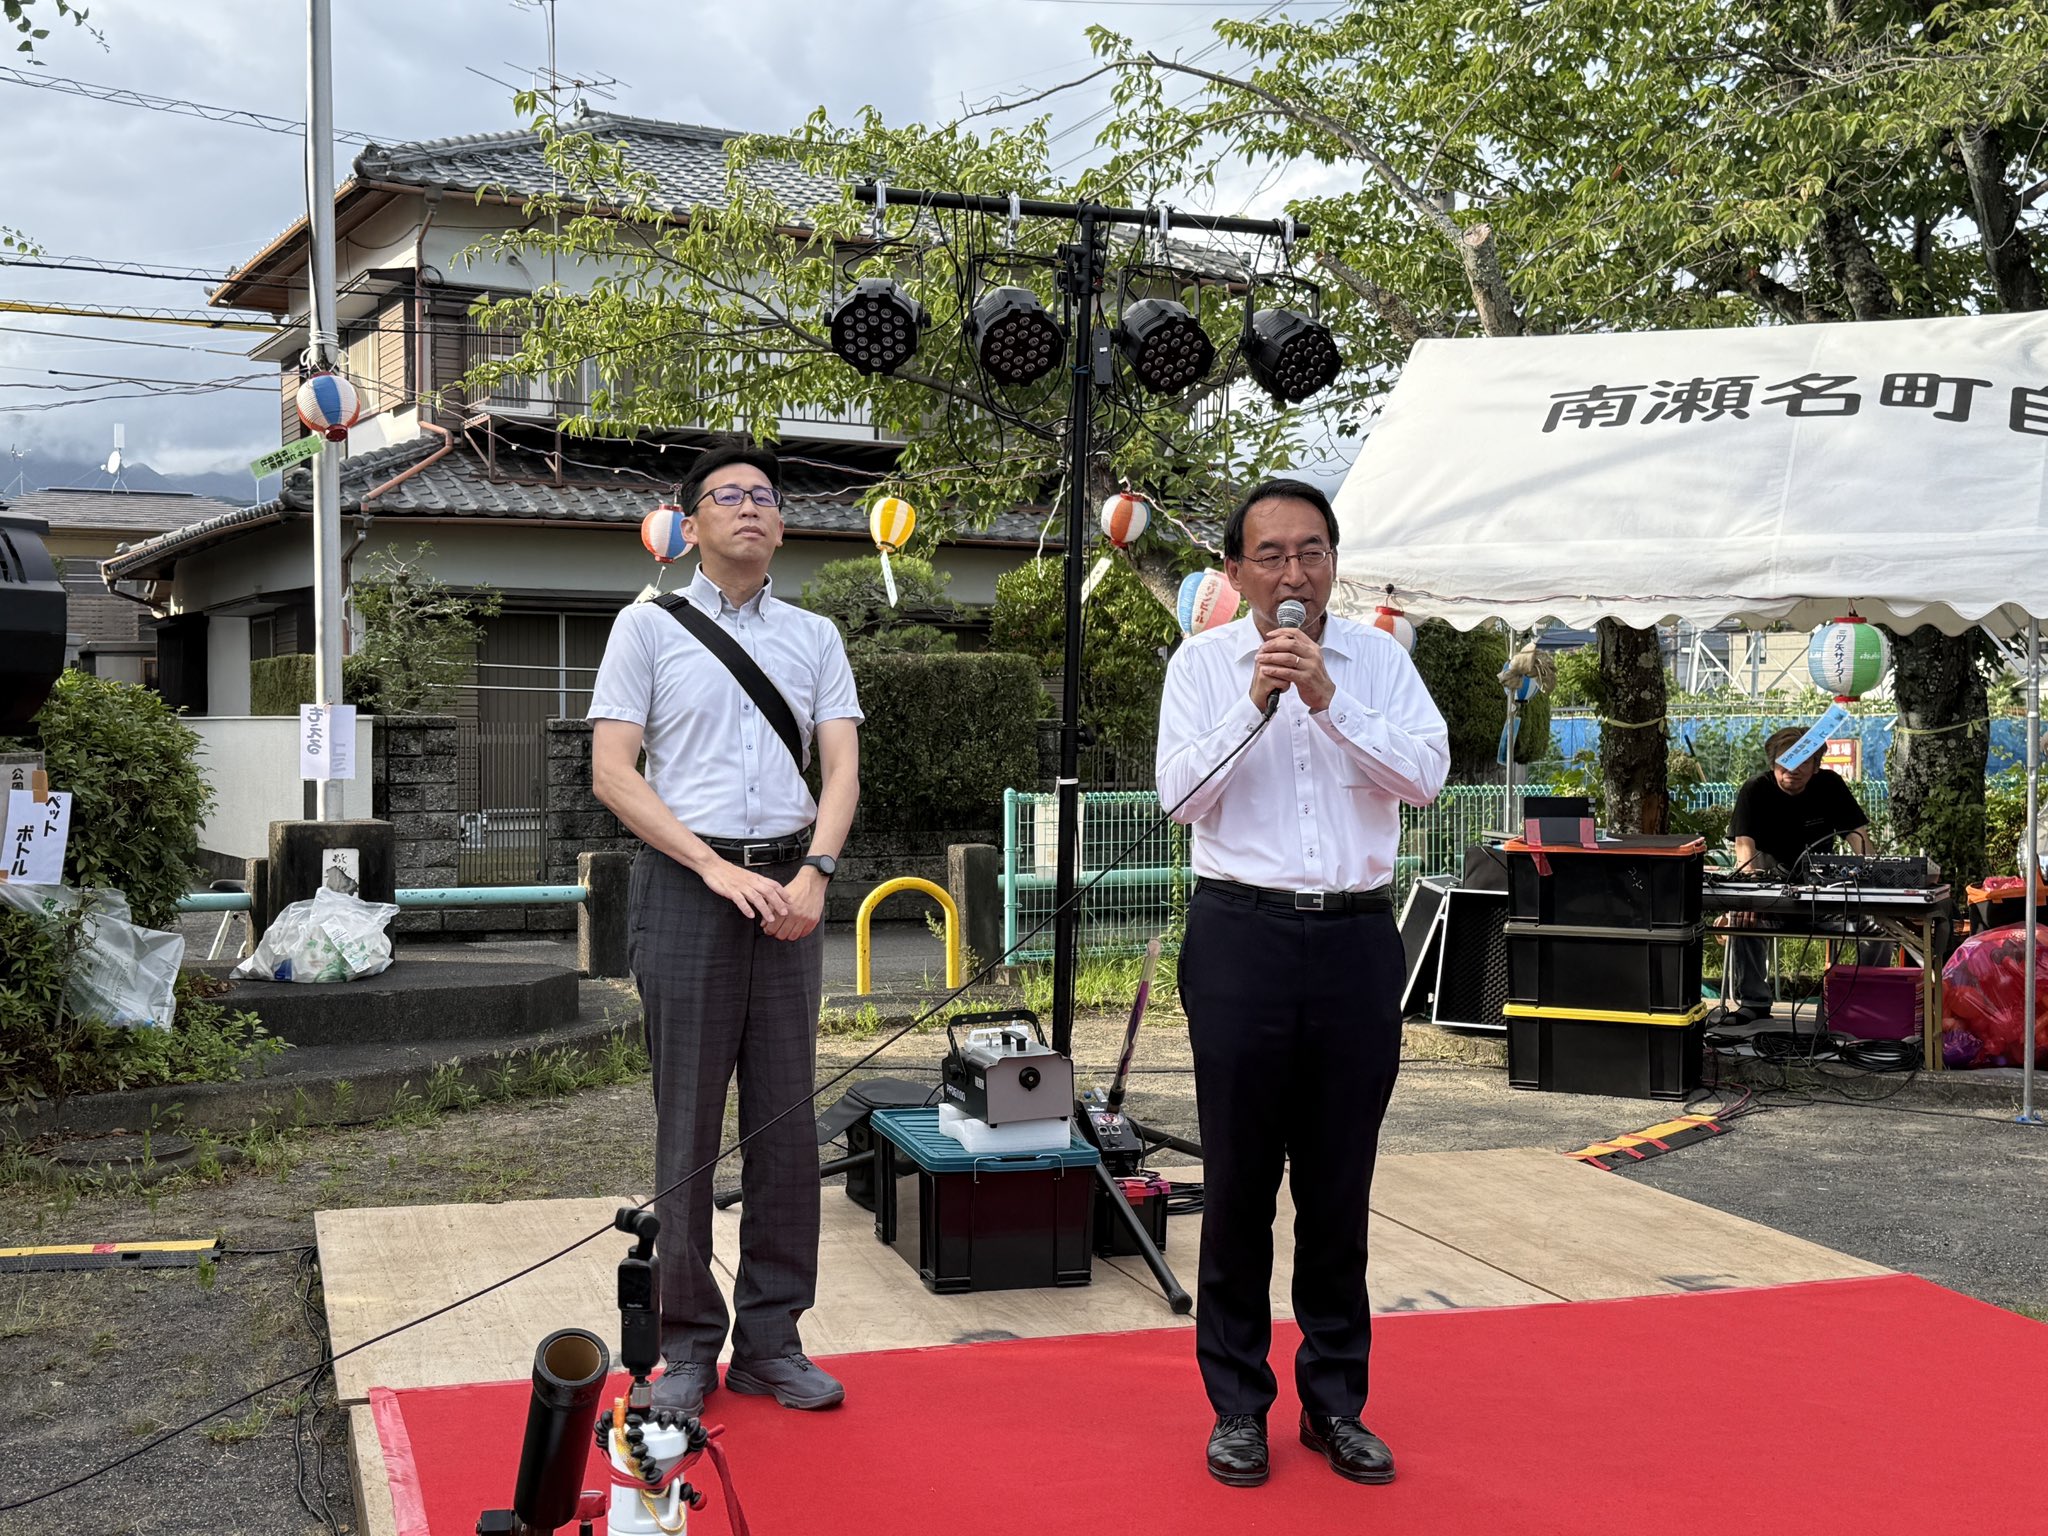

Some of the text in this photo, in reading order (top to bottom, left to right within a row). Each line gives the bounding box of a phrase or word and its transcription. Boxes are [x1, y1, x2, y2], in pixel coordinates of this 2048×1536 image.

[1834, 629, 1847, 684] 三ツ矢サイダー
[44, 795, 61, 837] ペット
[11, 825, 34, 875] ボトル
